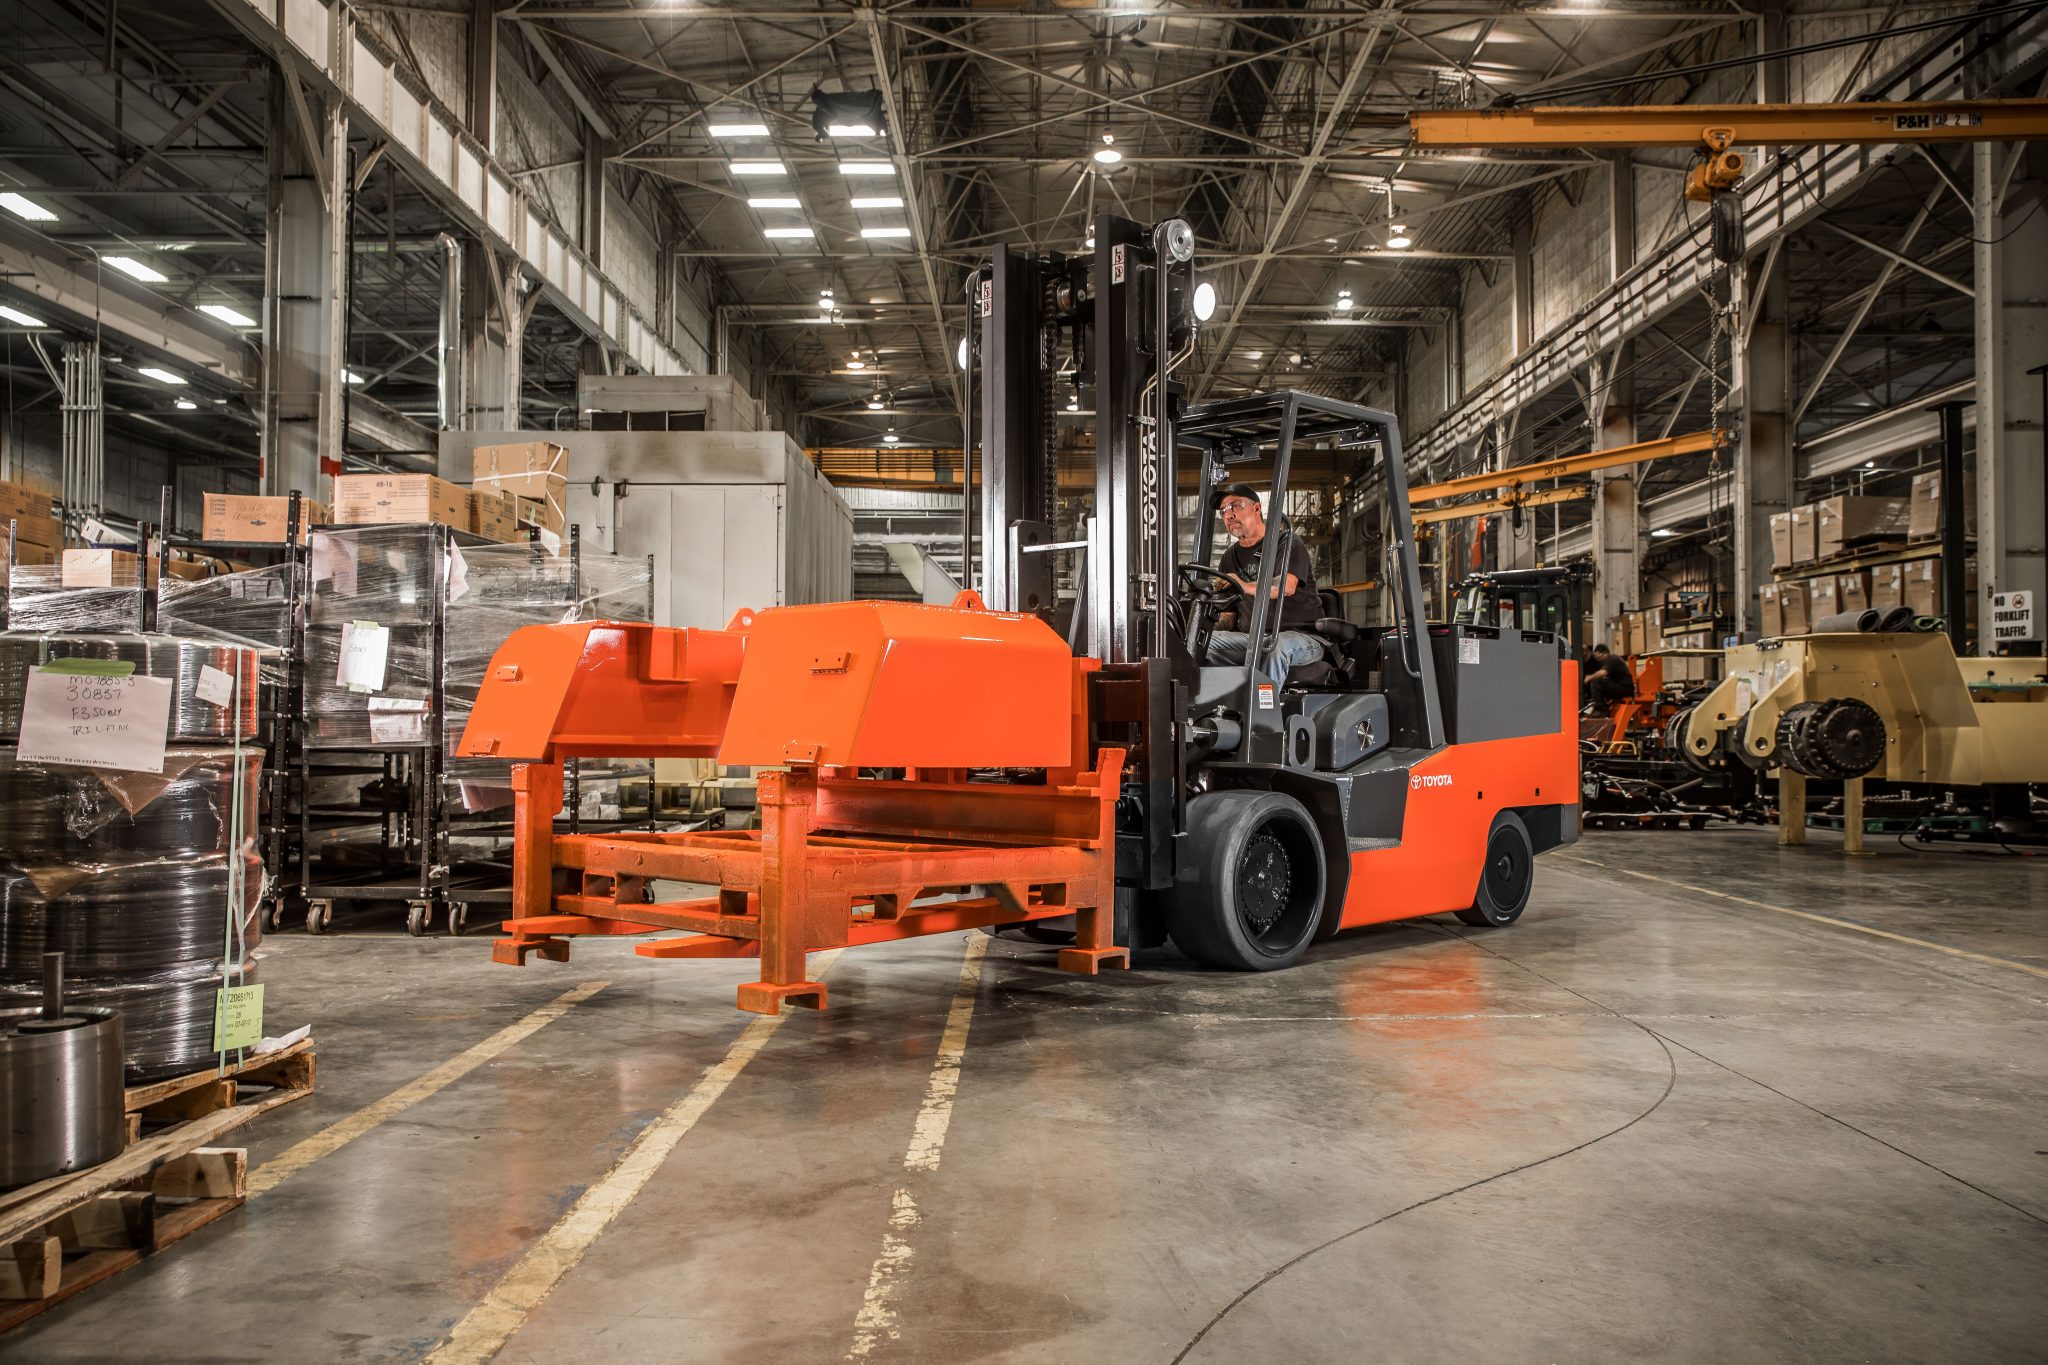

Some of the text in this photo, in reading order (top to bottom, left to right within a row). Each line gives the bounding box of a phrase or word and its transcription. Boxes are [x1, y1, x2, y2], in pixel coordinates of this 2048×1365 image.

[1896, 114, 1929, 129] P&H
[1955, 114, 1961, 126] 2
[1968, 113, 1983, 127] TON
[1142, 431, 1157, 541] TOYOTA
[1994, 596, 2005, 607] NO
[1994, 609, 2030, 622] FORKLIFT
[1994, 625, 2027, 638] TRAFFIC
[1422, 774, 1453, 787] TOYOTA
